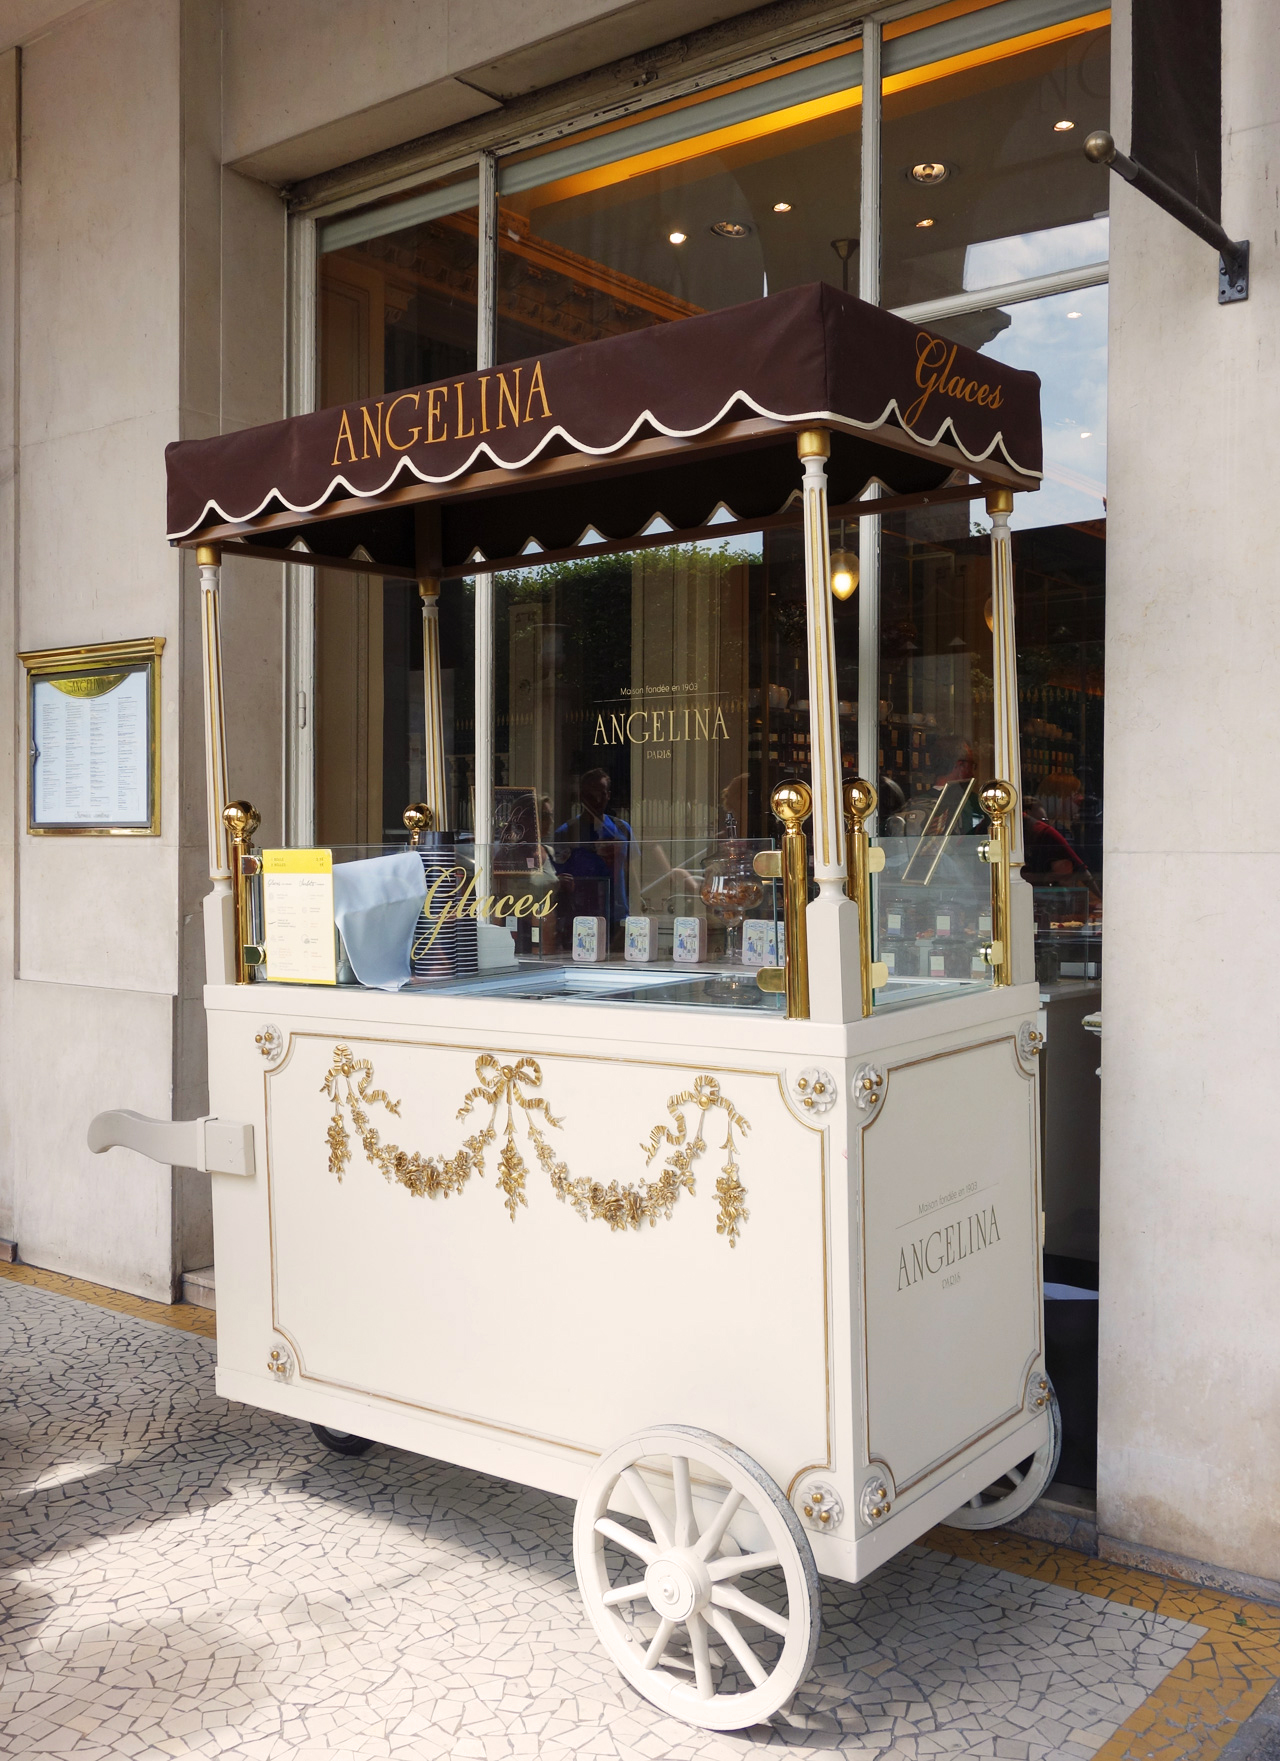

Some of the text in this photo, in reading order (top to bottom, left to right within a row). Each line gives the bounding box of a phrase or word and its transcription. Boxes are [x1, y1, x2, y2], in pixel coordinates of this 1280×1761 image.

[904, 332, 1004, 428] Glaces
[331, 360, 553, 466] ANGELINA
[620, 682, 699, 696] Maison fondée en 1903
[592, 706, 731, 746] ANGELINA
[646, 750, 672, 760] PARIS
[410, 866, 559, 961] Glaces
[918, 1181, 979, 1215] Maison fondée en 1903
[896, 1203, 1002, 1293] ANGELINA
